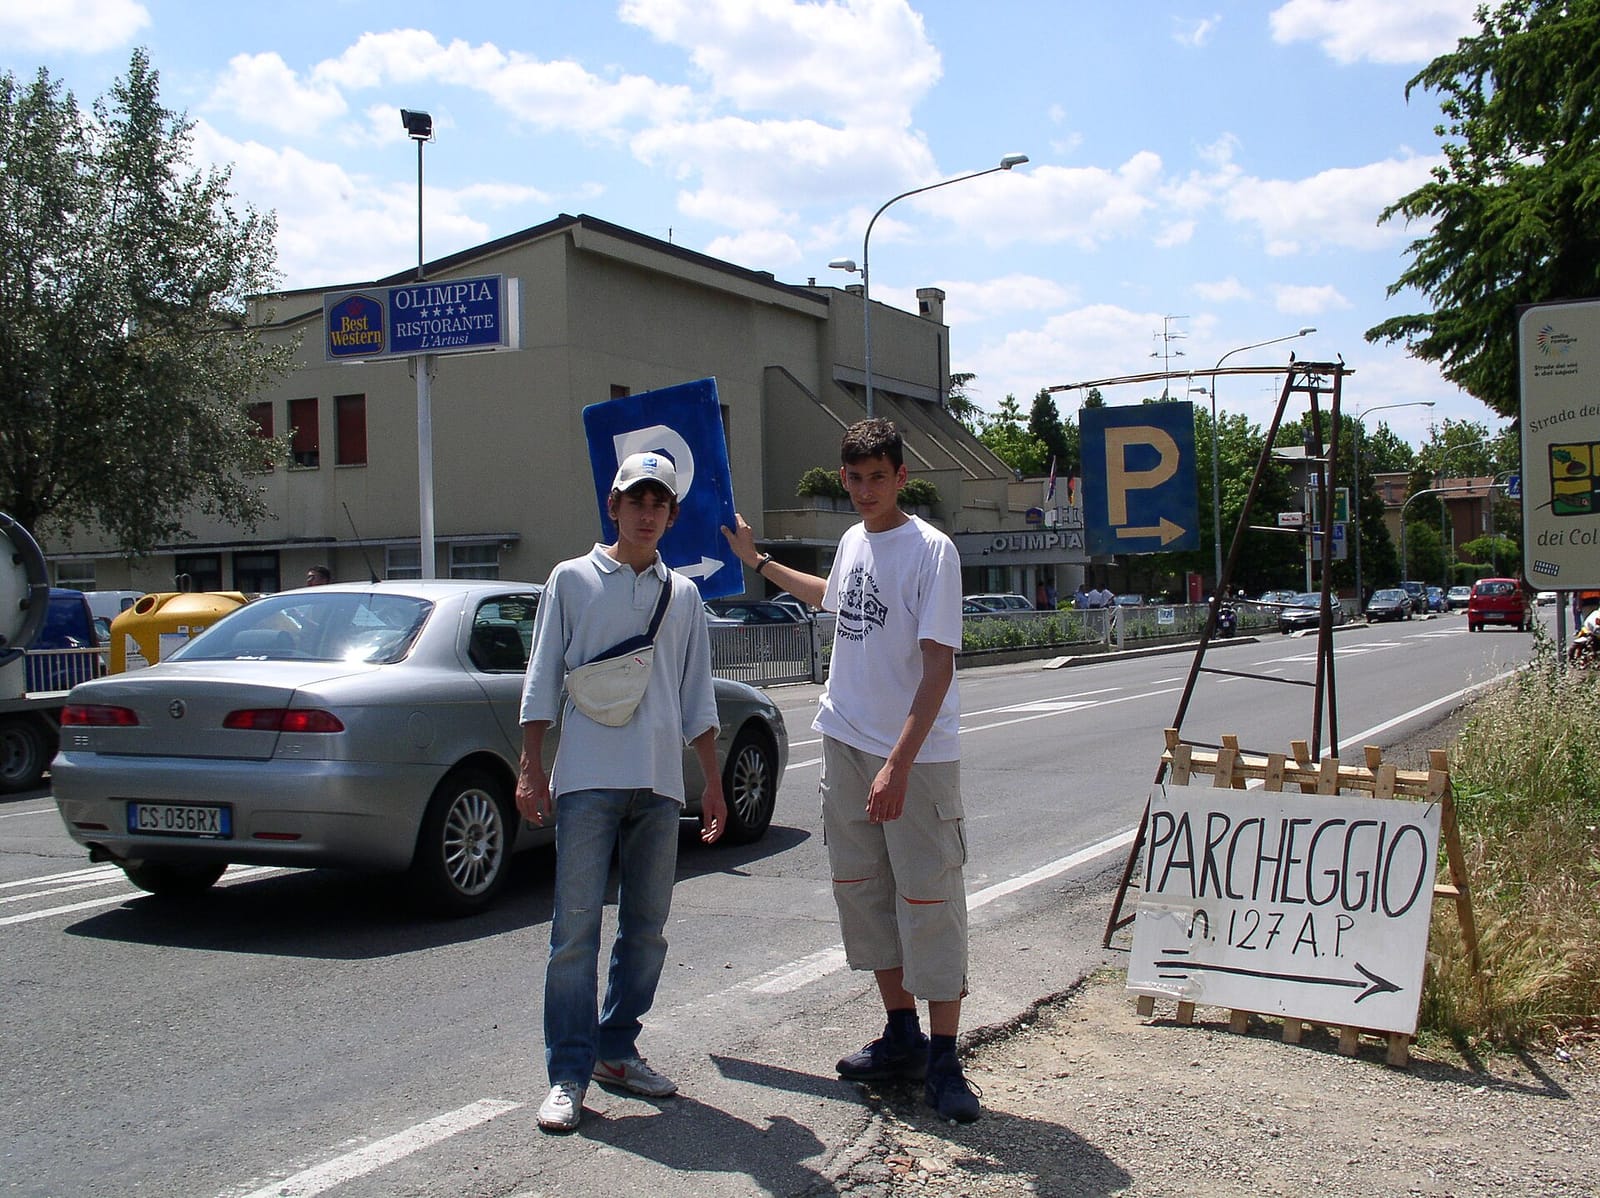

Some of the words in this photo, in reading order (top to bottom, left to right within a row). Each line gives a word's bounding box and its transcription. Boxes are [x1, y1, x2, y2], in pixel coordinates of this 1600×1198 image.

[395, 282, 493, 310] OLIMPIA
[340, 316, 368, 333] Best
[396, 314, 494, 338] RISTORANTE
[330, 330, 383, 347] Western
[420, 333, 470, 348] L'Artusi
[1529, 409, 1575, 433] Strada
[1104, 425, 1180, 526] P
[992, 533, 1082, 551] OLIMPIA
[1537, 530, 1564, 546] dei
[1145, 811, 1428, 918] PARCHEGGIO
[1228, 909, 1285, 950] 127
